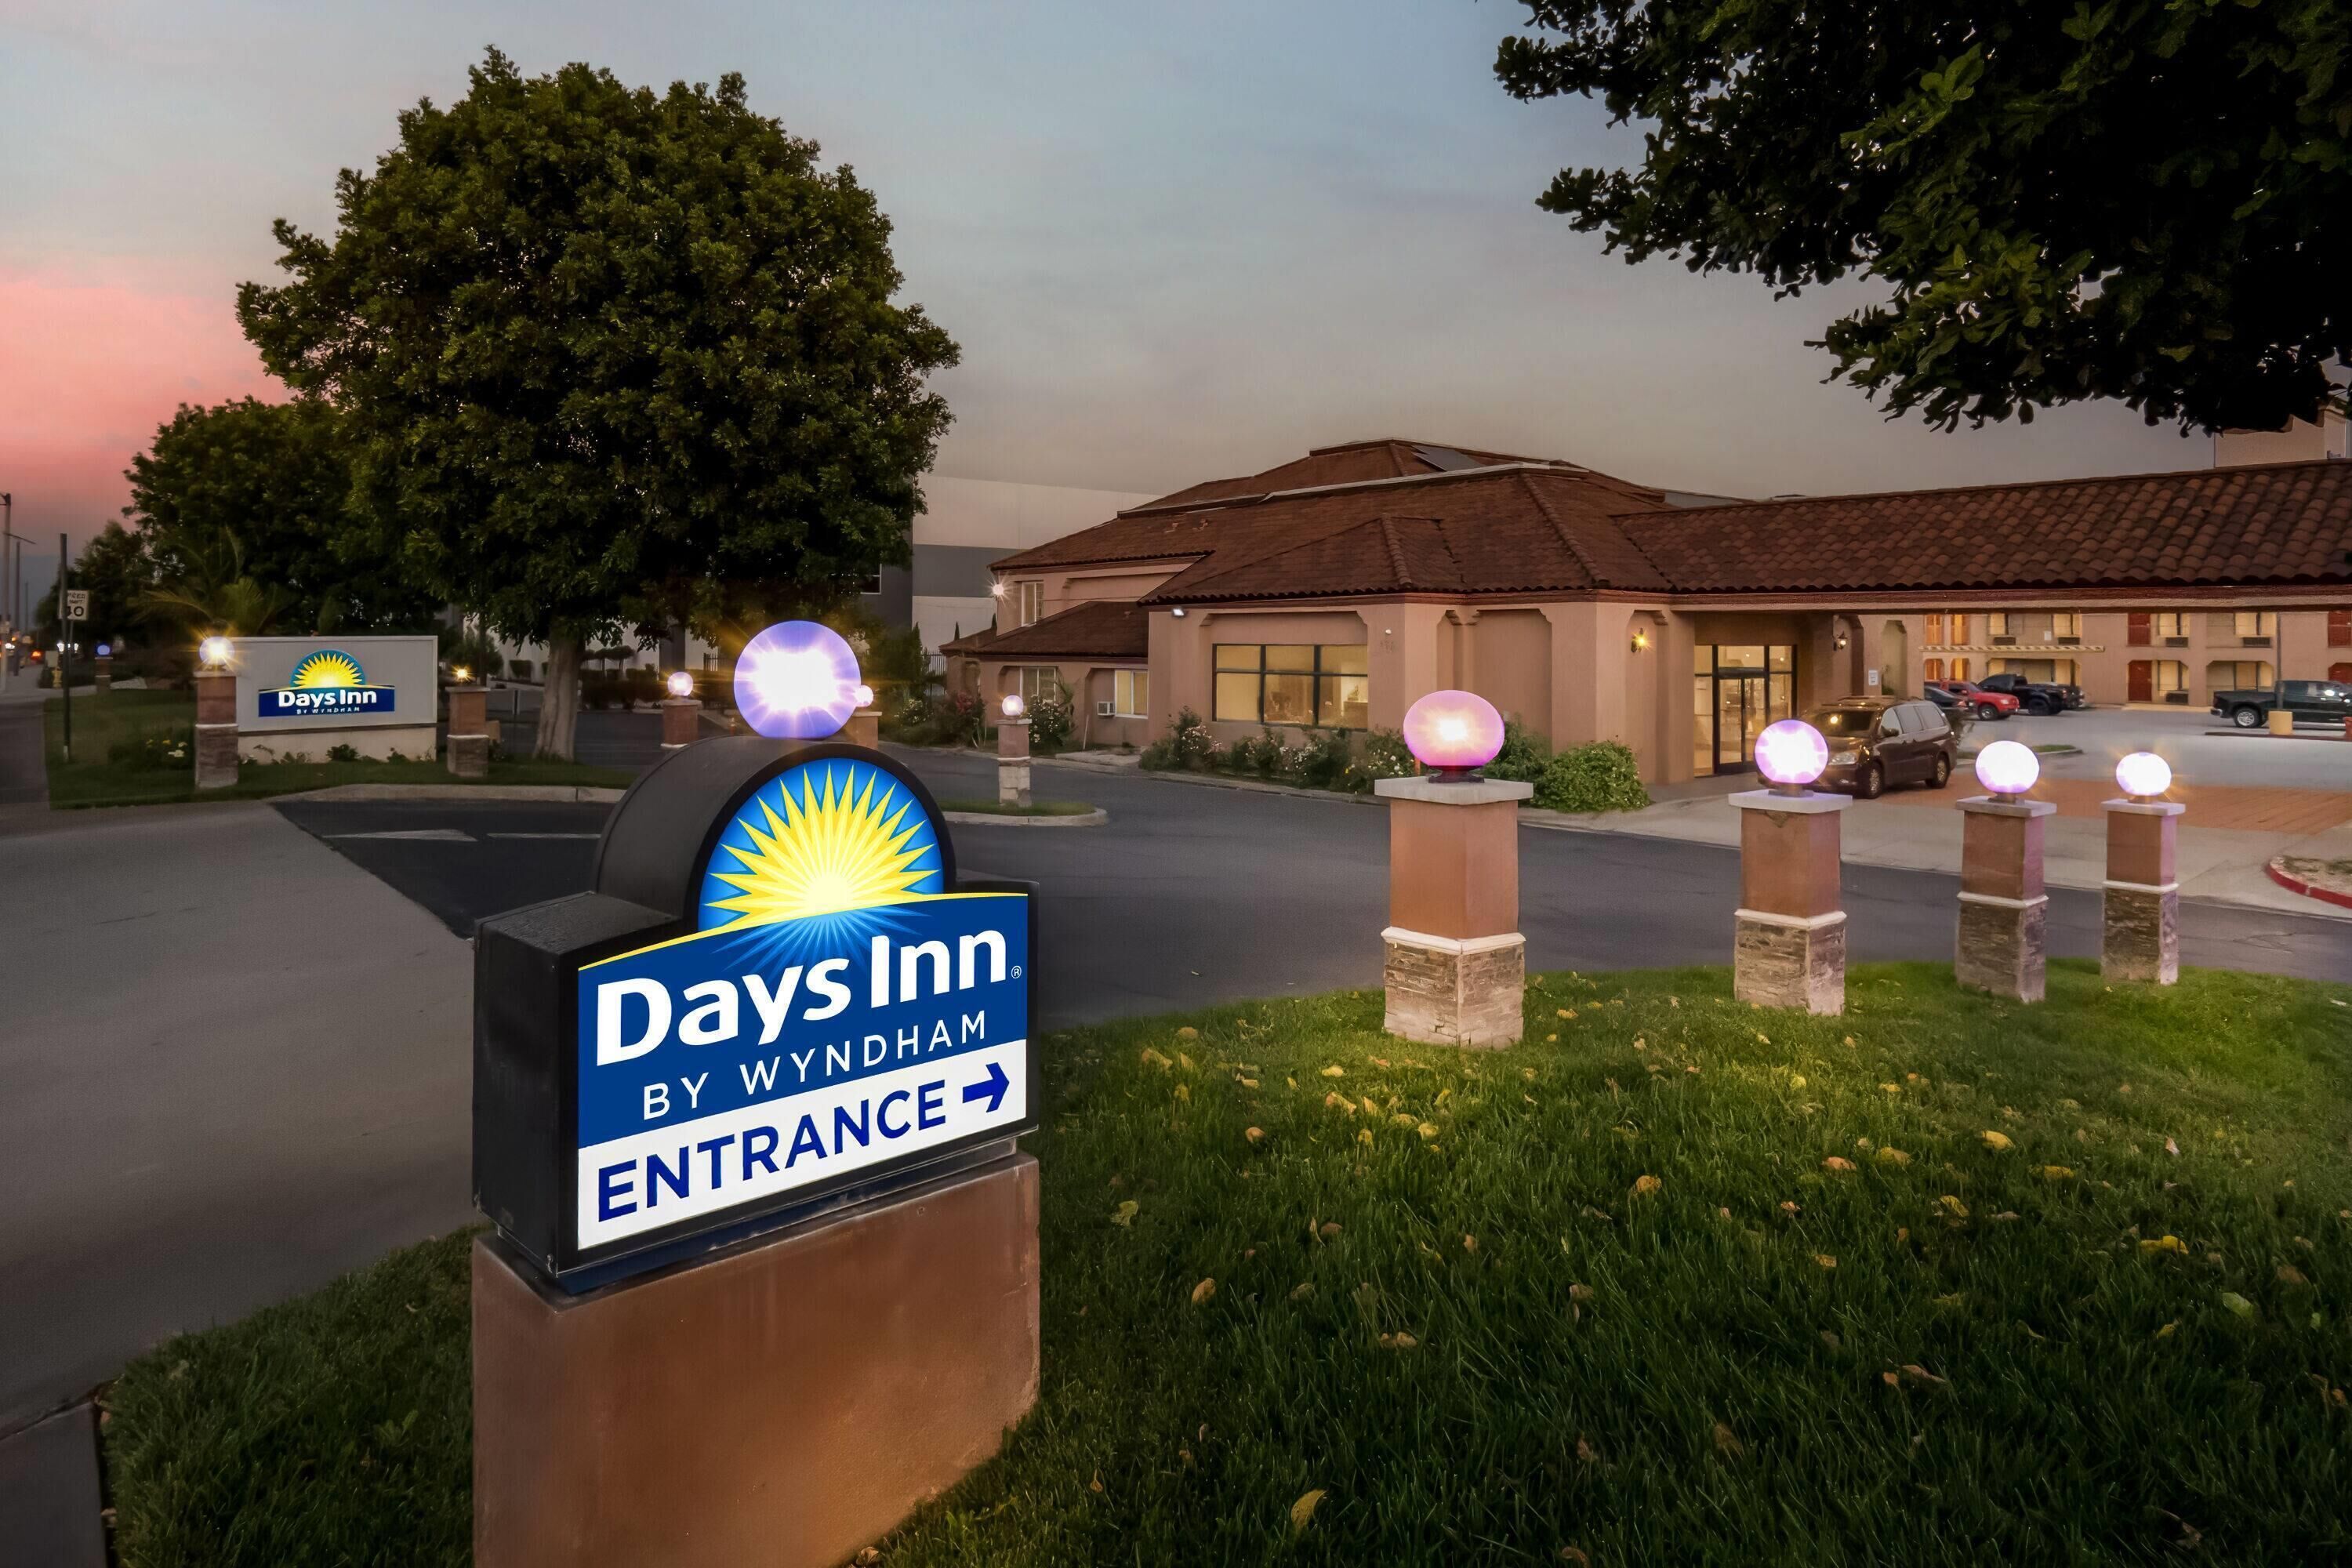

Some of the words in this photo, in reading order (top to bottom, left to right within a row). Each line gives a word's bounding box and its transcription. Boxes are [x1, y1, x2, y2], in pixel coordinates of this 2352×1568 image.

[278, 691, 336, 708] Days
[339, 689, 377, 705] Inn
[597, 959, 851, 1065] Days
[644, 1073, 709, 1120] BY
[740, 1011, 985, 1094] WYNDHAM
[599, 1080, 946, 1222] ENTRANCE
